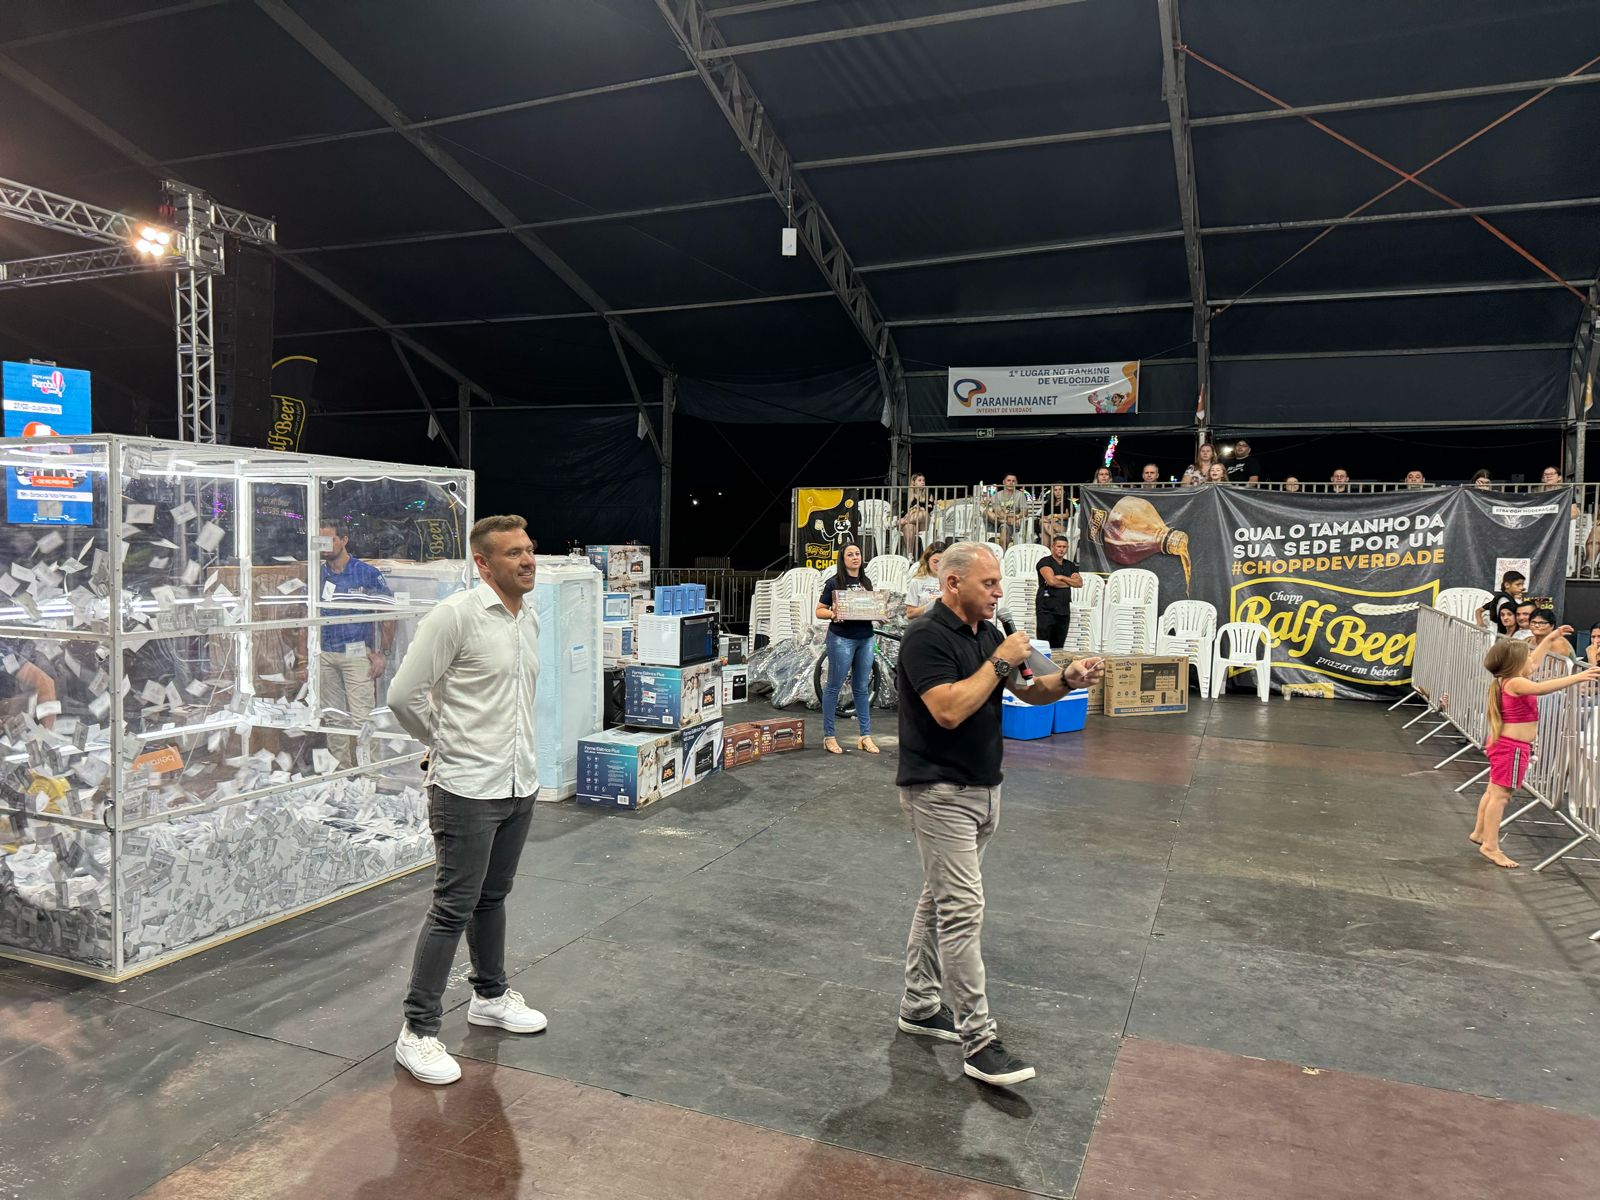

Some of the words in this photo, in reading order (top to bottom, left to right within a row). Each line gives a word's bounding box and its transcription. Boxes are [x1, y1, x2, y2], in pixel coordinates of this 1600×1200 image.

[1020, 369, 1050, 377] LUGAR
[1053, 368, 1066, 376] NO
[1068, 367, 1110, 375] RANKING
[1053, 375, 1110, 384] VELOCIDADE
[976, 395, 1058, 407] PARANHANANET
[274, 398, 295, 434] Beer
[429, 520, 445, 554] Beer
[1234, 525, 1286, 542] QUAL
[1288, 524, 1306, 539] O
[1309, 516, 1410, 538] TAMANHO
[1414, 513, 1445, 530] DA
[1233, 543, 1276, 559] SUA
[1284, 538, 1341, 556] SEDE
[1350, 534, 1400, 552] POR
[1409, 530, 1444, 548] UM
[1231, 548, 1445, 576] #CHOPPDEVERDADE
[1269, 591, 1303, 605] Chopp
[1235, 596, 1338, 657] Ralf
[1316, 656, 1350, 671] prazer
[1352, 666, 1367, 675] em
[1370, 665, 1400, 677] beber
